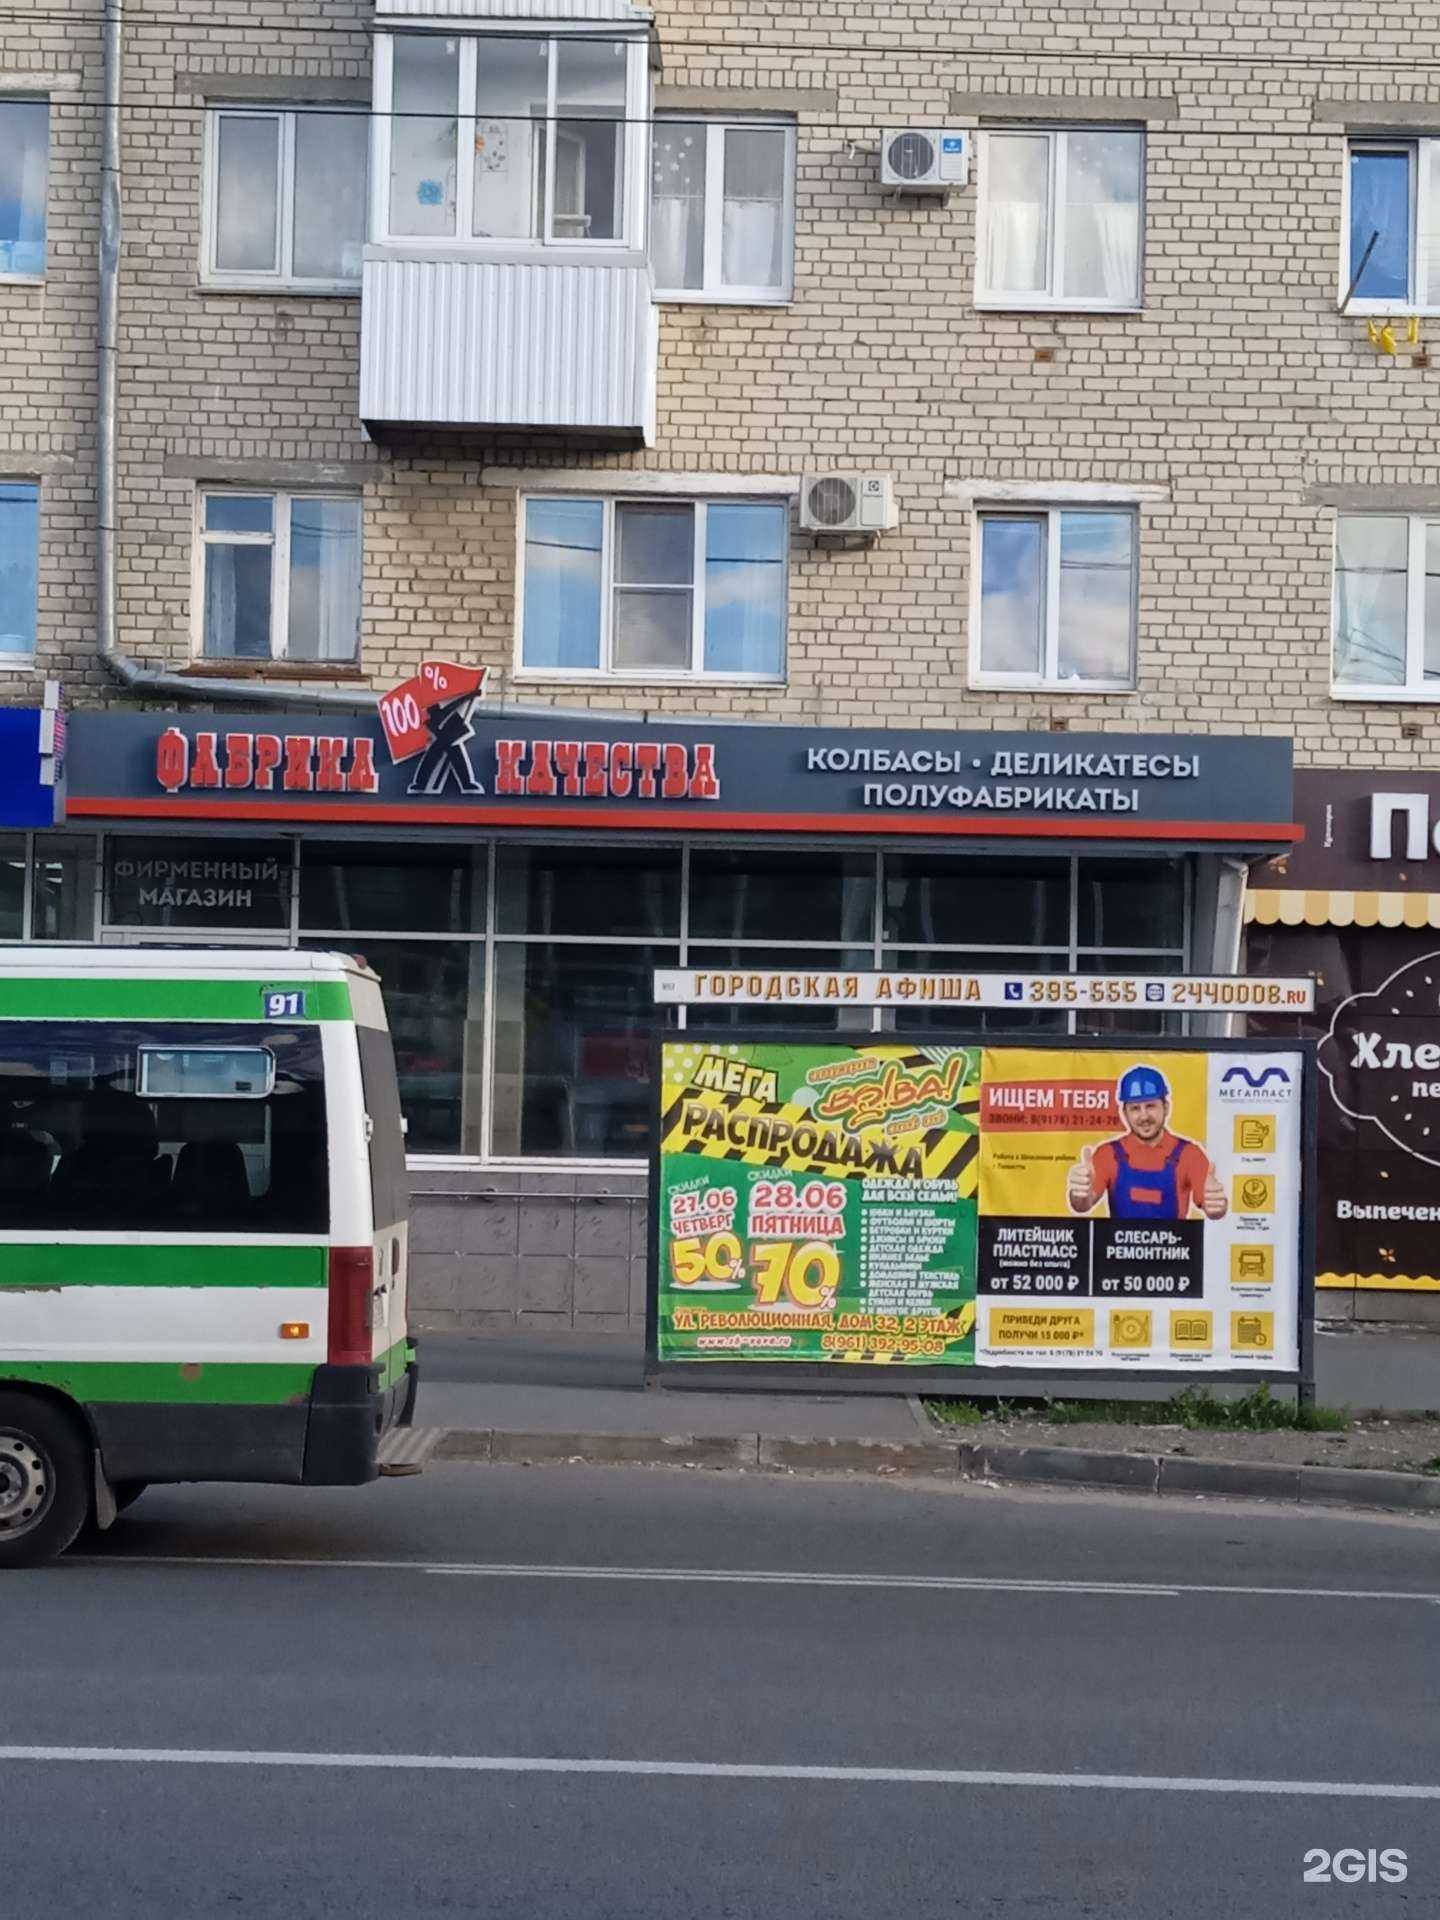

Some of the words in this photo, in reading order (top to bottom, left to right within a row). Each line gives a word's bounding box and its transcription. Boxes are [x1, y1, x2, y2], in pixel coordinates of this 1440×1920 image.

[382, 694, 422, 737] 100
[156, 726, 380, 794] ФАБРИКА
[494, 739, 721, 800] КАЧЕСТВА
[806, 747, 962, 774] КОЛБАСЫ
[990, 751, 1201, 778] ДЕЛИКАТЕСЫ
[863, 783, 1140, 813] ПОЛУФАБРИКАТЫ
[1370, 792, 1440, 860] П
[114, 857, 279, 881] ФИРМЕННЫЙ
[138, 887, 252, 908] МАГАЗИН
[694, 974, 858, 1001] ГОРОДСКАЯ
[876, 976, 982, 1001] АФИША
[1029, 981, 1138, 1003] 395-555
[268, 993, 299, 1015] 91
[694, 1055, 779, 1104] МЕГА
[989, 1088, 1054, 1110] ИЩЕМ
[1060, 1089, 1110, 1109] ТЕБЯ
[1219, 1089, 1292, 1098] МЕГАПЛАСТ
[682, 1104, 923, 1179] РАСПРОДАЖА
[672, 1190, 736, 1215] 27.06
[754, 1183, 844, 1210] 28.06
[672, 1214, 733, 1234] ЧЕТВЕРГ
[752, 1214, 844, 1235] ПЯТНИЦА
[997, 1227, 1074, 1244] ЛИТЕЙЩИК
[1115, 1231, 1182, 1244] СЛЕСАРЬ-
[671, 1231, 745, 1284] 50%
[993, 1244, 1078, 1258] ПЛАСТМАСС
[1106, 1246, 1190, 1259] РЕМОНТНИК
[753, 1240, 840, 1308] 70%
[990, 1278, 1009, 1289] от
[1013, 1275, 1031, 1290] 52
[1035, 1275, 1063, 1290] 000
[1102, 1279, 1120, 1290] от
[1124, 1276, 1142, 1291] 50
[1146, 1276, 1174, 1291] 000
[674, 1313, 694, 1329] УЛ.
[839, 1316, 872, 1331] ДОМ
[904, 1317, 915, 1332] 2
[920, 1317, 961, 1334] ЭТАЖ
[1003, 1315, 1047, 1325] ПРИВЕДИ
[1050, 1315, 1080, 1326] ДРУГА
[870, 1337, 945, 1352] 392-95-08
[998, 1330, 1037, 1339] ПОЛУЧИ
[1053, 1331, 1070, 1340] 000
